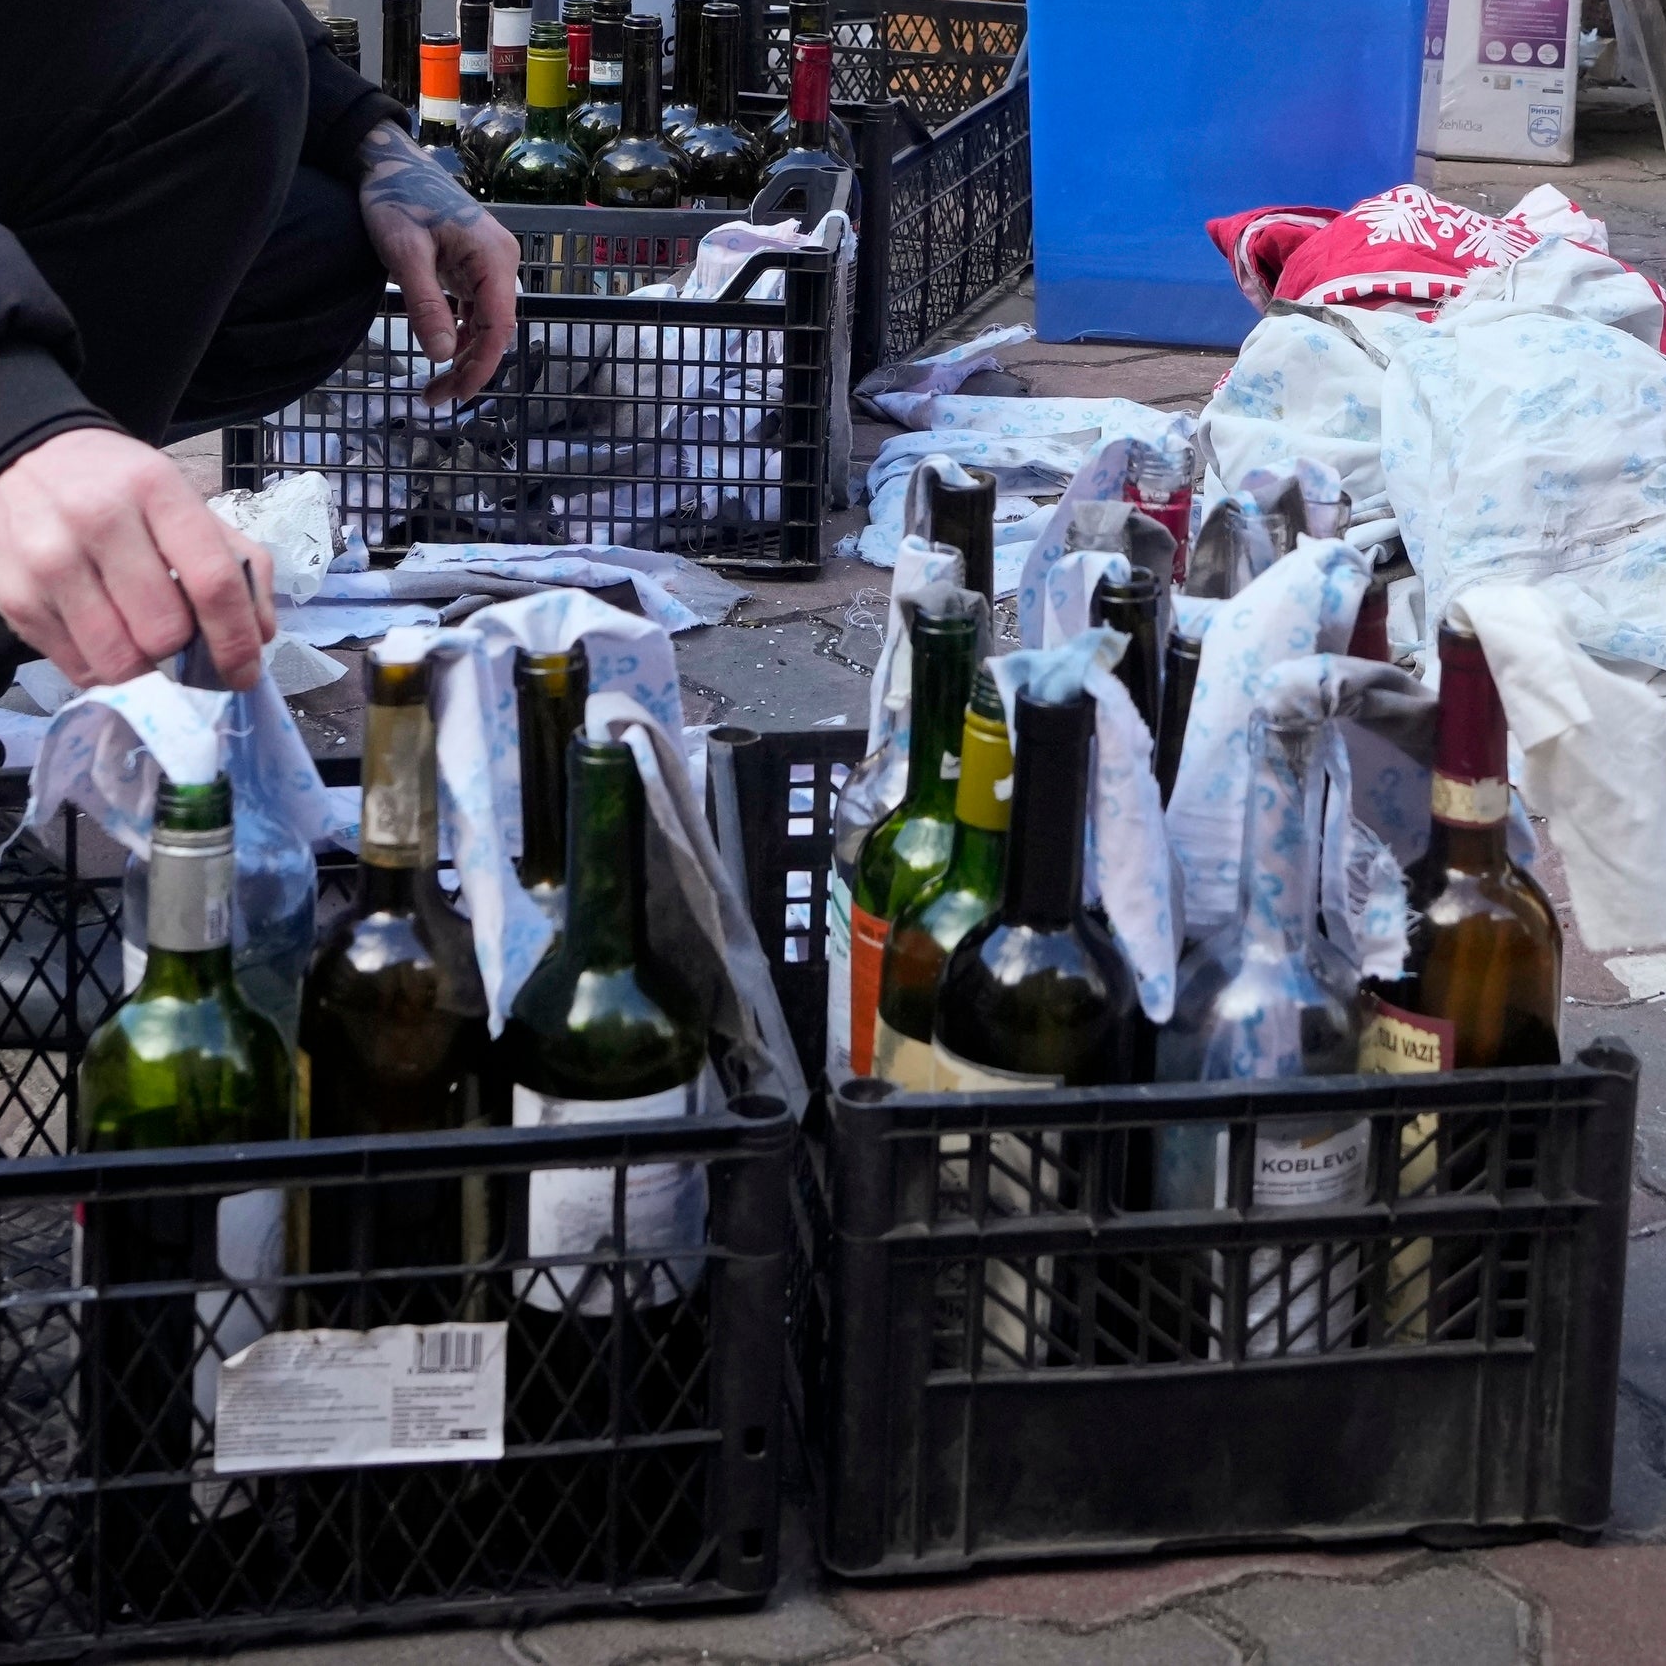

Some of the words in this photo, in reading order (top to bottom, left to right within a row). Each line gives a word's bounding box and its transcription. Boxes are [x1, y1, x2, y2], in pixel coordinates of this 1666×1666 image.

[1530, 108, 1560, 116] PHILIPS
[1438, 117, 1483, 133] žehlička
[1402, 1038, 1434, 1063] VAZI
[1260, 1144, 1358, 1175] KOBLEVO
